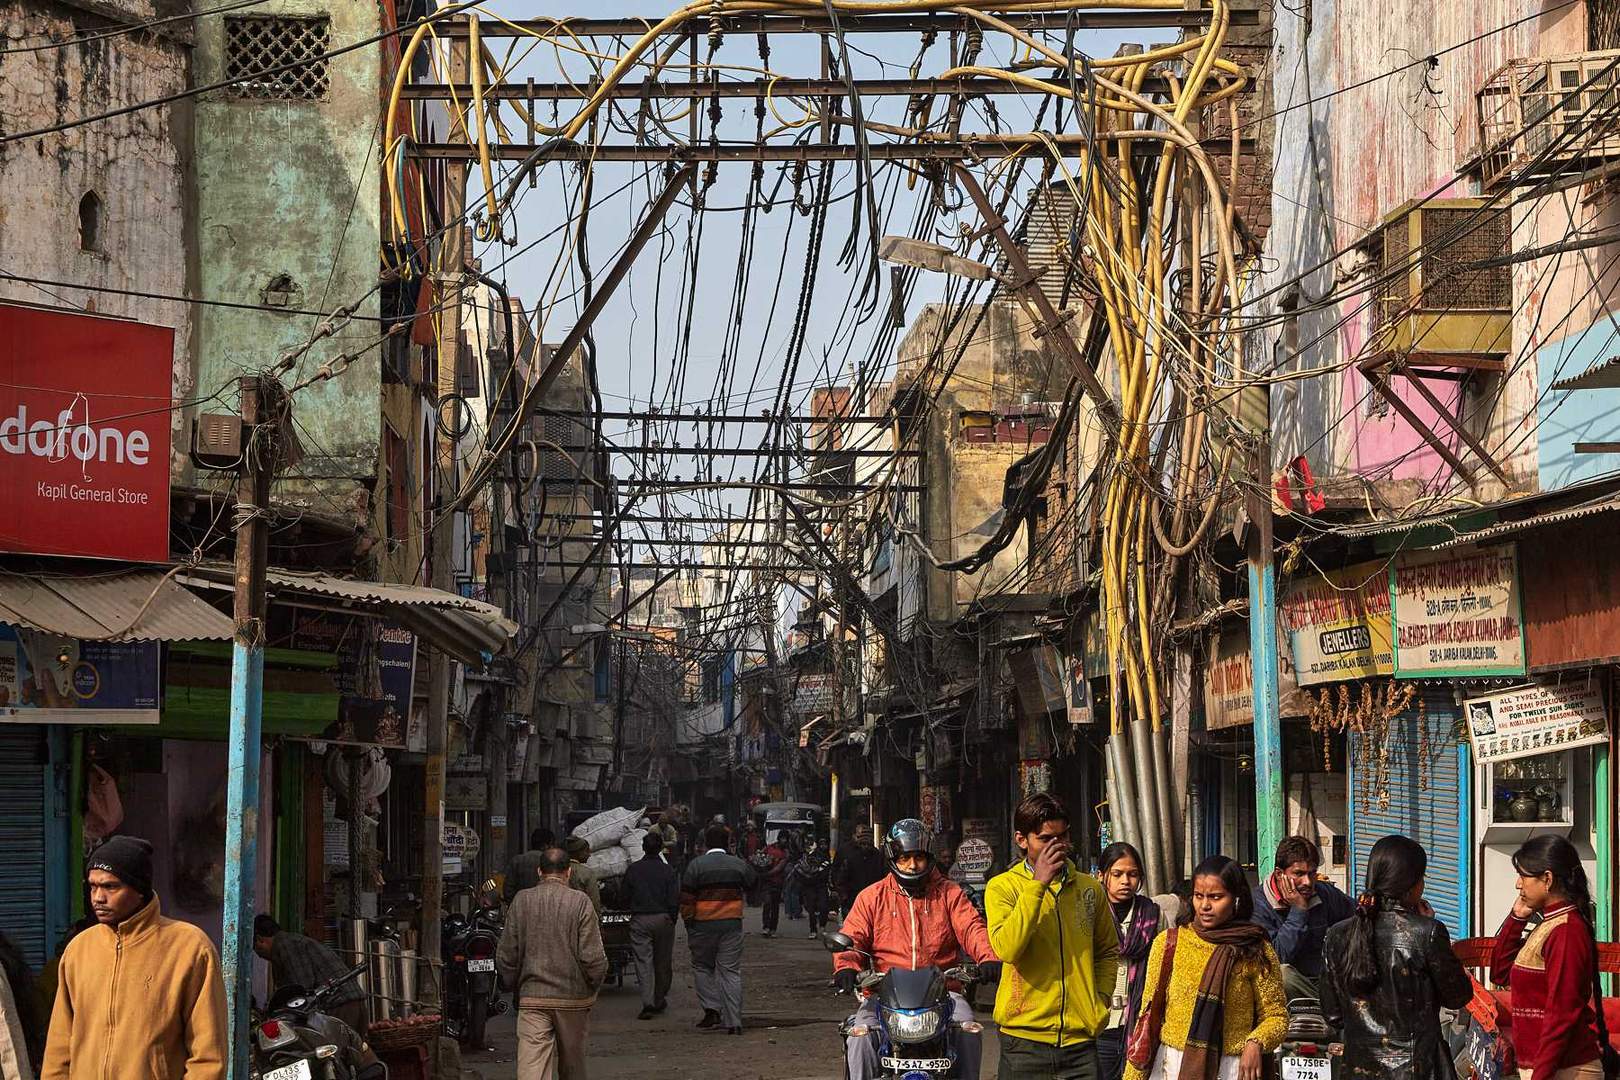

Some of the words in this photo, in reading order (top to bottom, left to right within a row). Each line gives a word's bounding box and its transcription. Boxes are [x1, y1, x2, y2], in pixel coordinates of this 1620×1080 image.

[37, 481, 67, 501] Kapil
[70, 484, 115, 503] General
[118, 488, 148, 505] Store
[373, 623, 412, 645] Centre
[1429, 621, 1453, 645] KUMAR
[1453, 620, 1474, 644] ASHOK
[1475, 617, 1498, 641] KUMAR
[1322, 628, 1370, 655] JEWELLERS
[1340, 657, 1356, 670] KALAN
[1516, 692, 1538, 702] TYPES
[1552, 683, 1585, 696] PRECIOUS
[1516, 703, 1534, 711] SEMI
[1535, 696, 1568, 708] PRECIOUS
[1569, 690, 1597, 701] STONES
[1509, 712, 1523, 720] FOR
[1523, 708, 1547, 717] TWELVE
[1549, 705, 1563, 713] SUN
[1564, 701, 1585, 711] SIGNS
[1509, 717, 1539, 727] AVAILABLE
[1549, 710, 1585, 720] REASONABLE
[883, 1058, 894, 1067] DL
[1297, 1070, 1319, 1080] 7724
